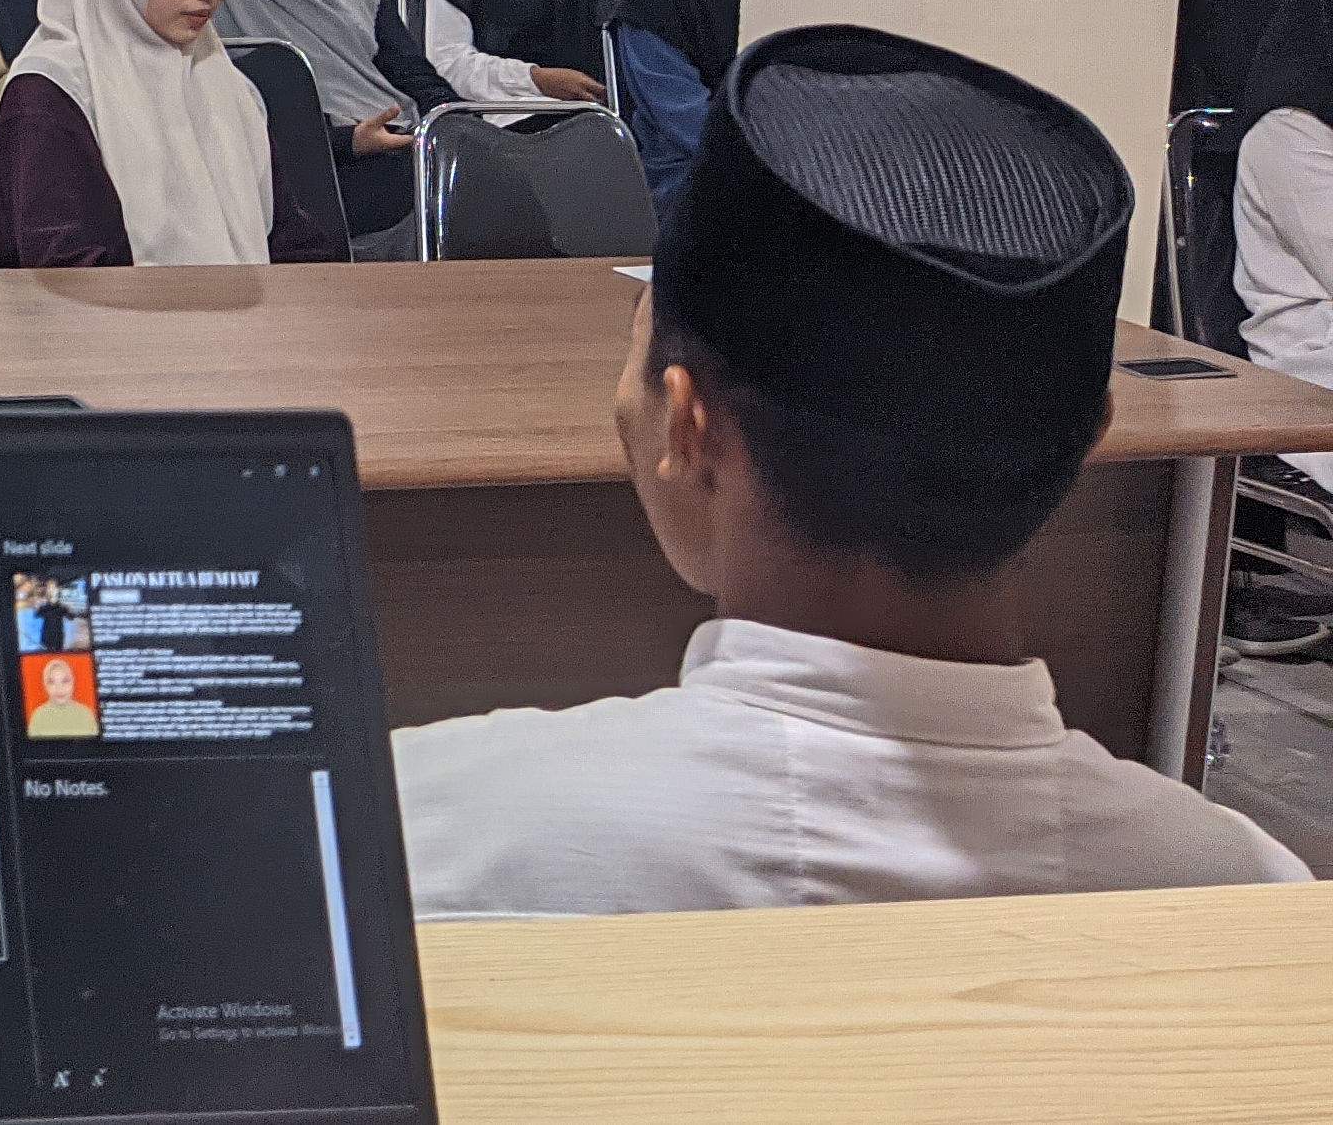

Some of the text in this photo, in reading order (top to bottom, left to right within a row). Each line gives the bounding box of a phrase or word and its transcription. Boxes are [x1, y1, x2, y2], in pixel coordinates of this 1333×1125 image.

[3, 540, 73, 555] Next slide
[24, 780, 51, 797] No
[156, 1000, 293, 1021] Activate Windows
